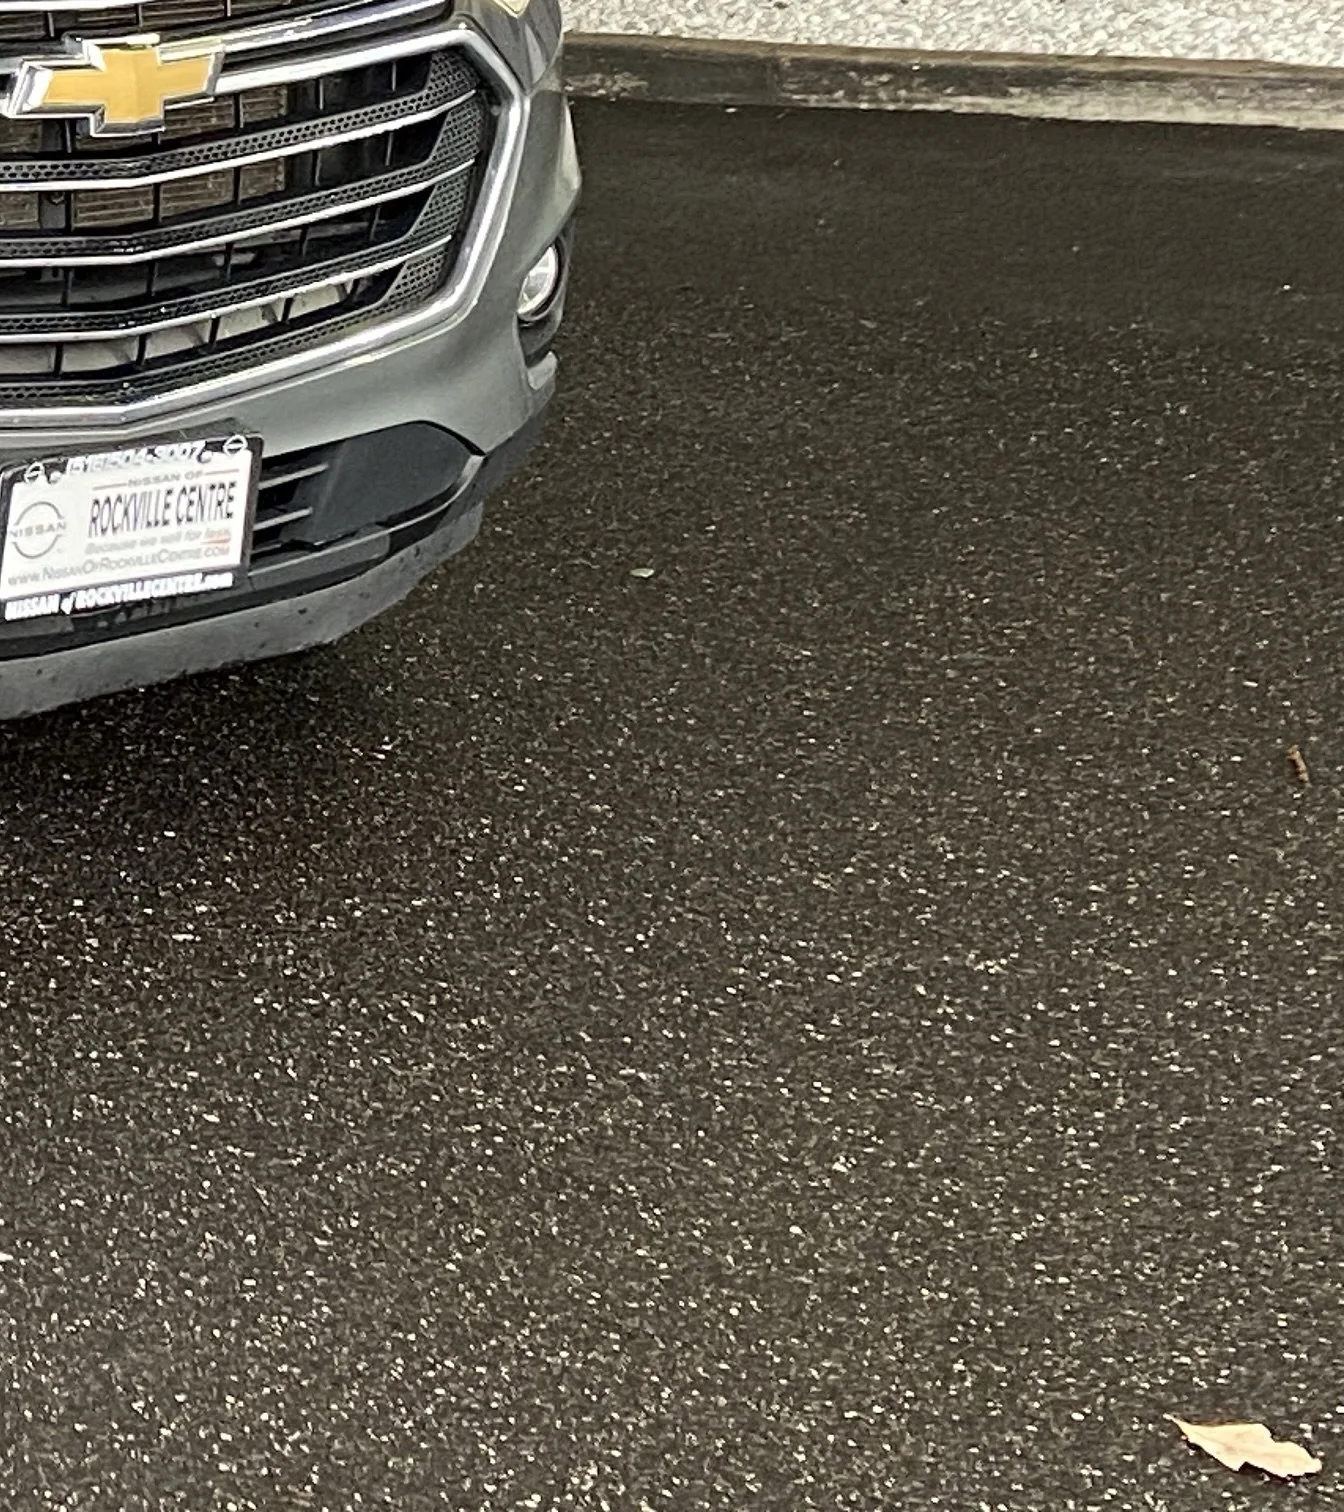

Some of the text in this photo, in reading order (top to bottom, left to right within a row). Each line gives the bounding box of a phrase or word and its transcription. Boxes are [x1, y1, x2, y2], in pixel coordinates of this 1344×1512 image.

[128, 471, 181, 487] NISSAN
[88, 480, 237, 538] ROCKVILLE CENTRE
[8, 521, 67, 539] NISSAN
[5, 593, 60, 622] NISSAN
